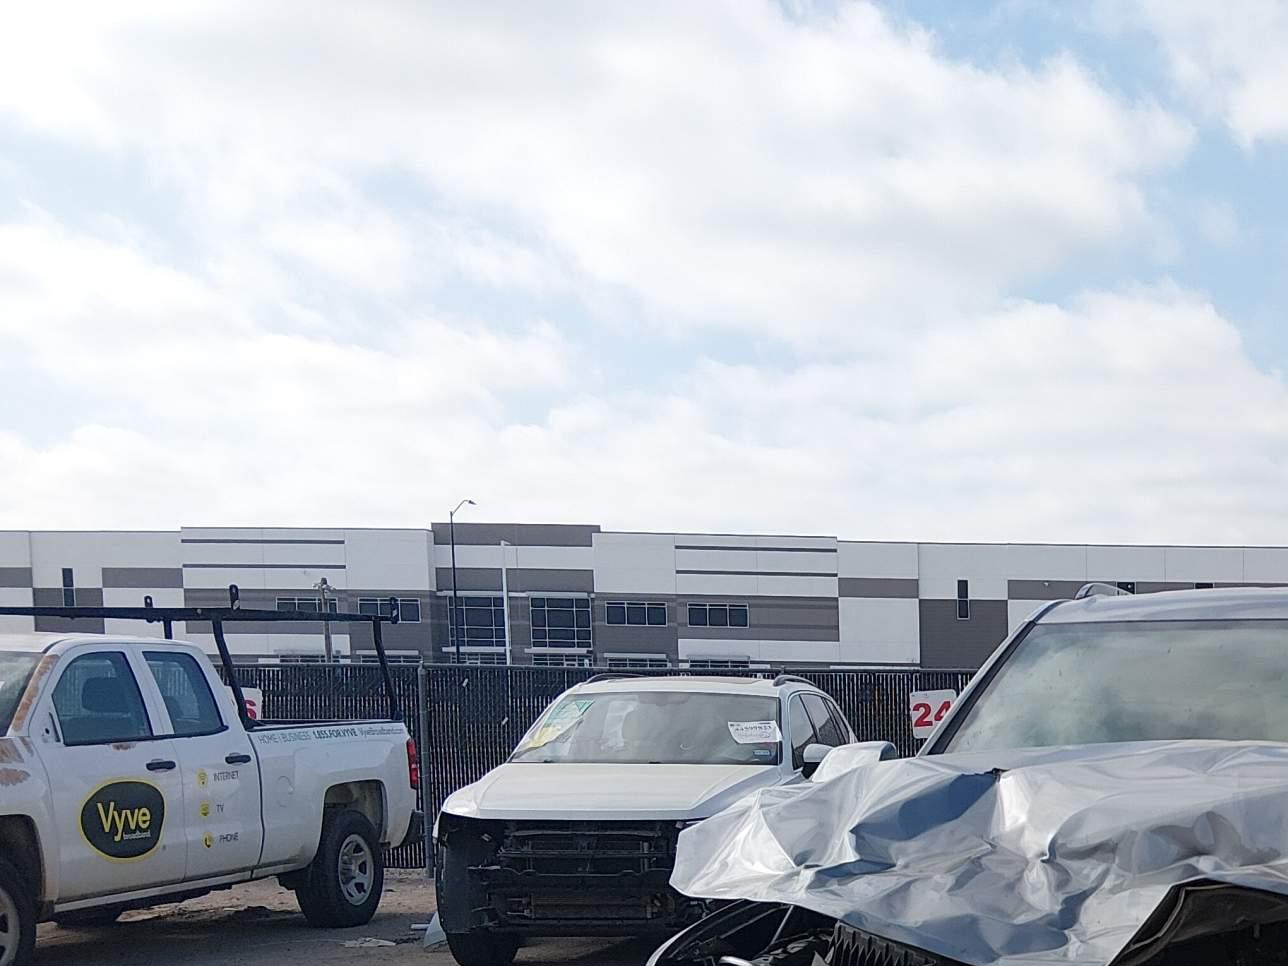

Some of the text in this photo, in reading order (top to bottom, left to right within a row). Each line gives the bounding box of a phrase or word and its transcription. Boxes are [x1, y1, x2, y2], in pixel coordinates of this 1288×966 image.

[213, 770, 239, 781] INTERNET
[216, 804, 224, 813] TV
[97, 801, 151, 842] Vyve
[219, 832, 239, 843] PHONE
